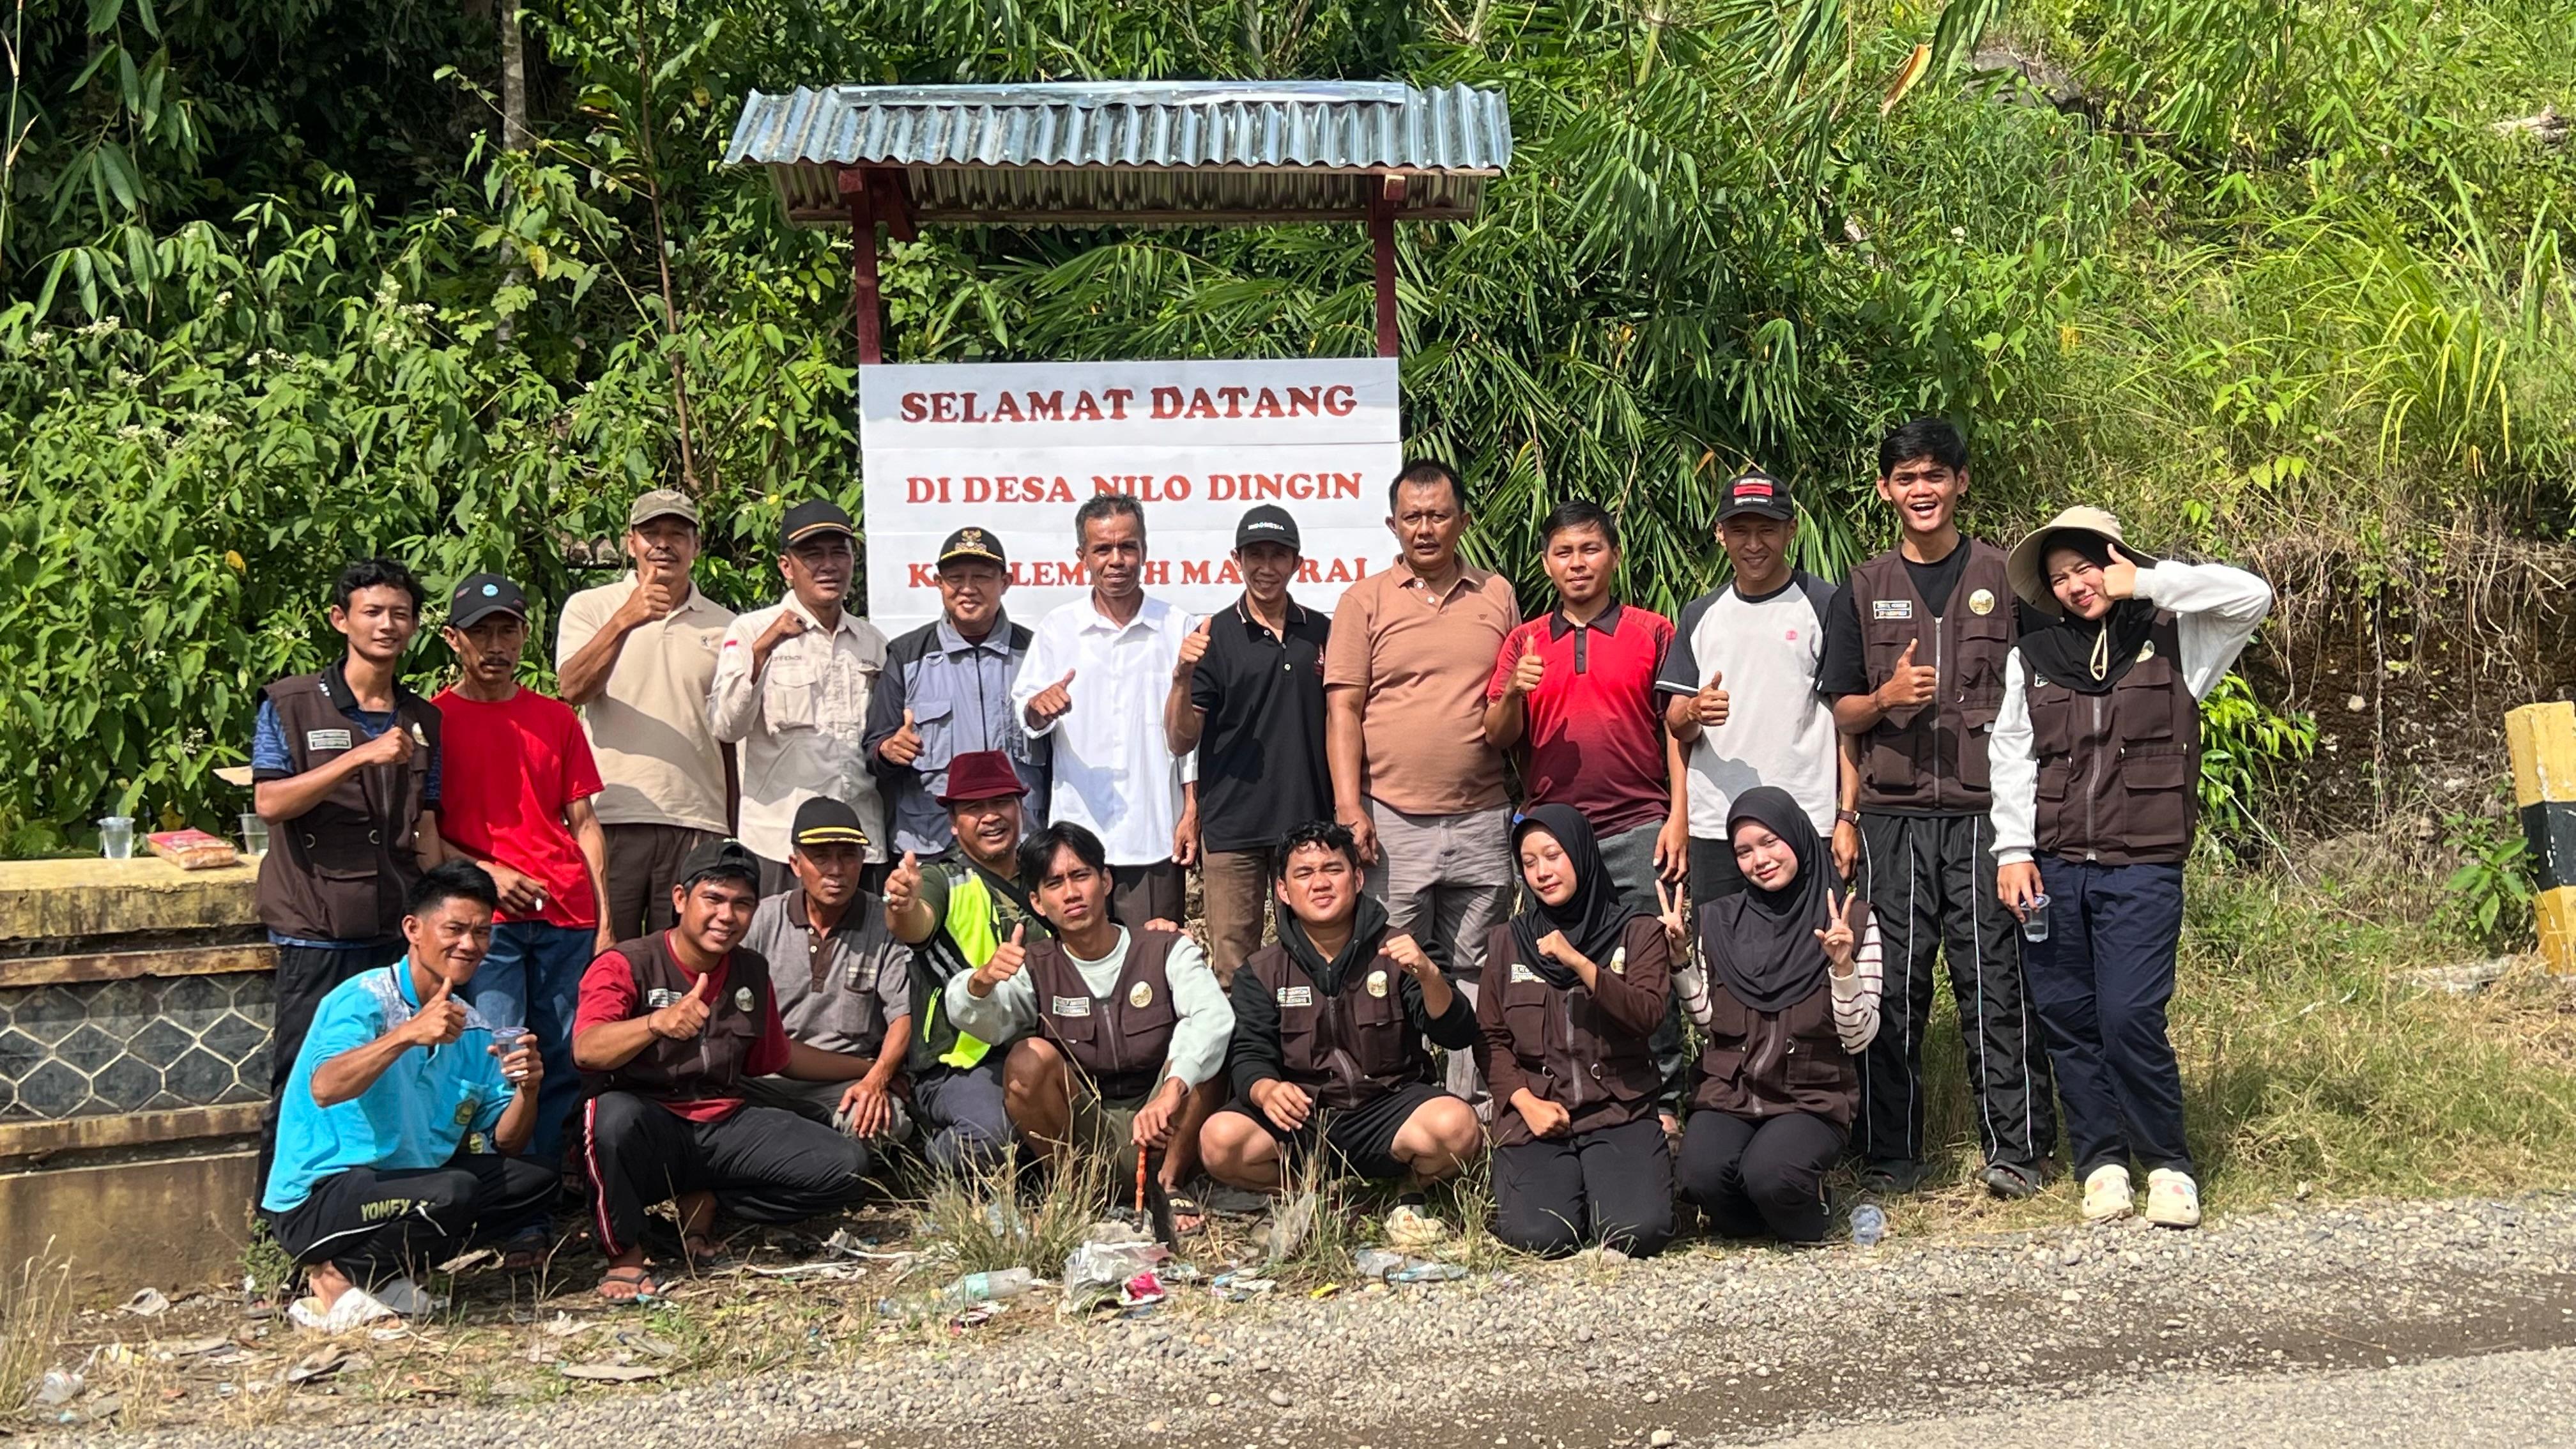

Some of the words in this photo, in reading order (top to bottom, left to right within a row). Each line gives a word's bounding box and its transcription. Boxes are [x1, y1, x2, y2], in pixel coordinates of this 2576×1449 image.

[901, 389, 1134, 422] SELAMAT
[1150, 385, 1357, 419] DATANG
[906, 476, 951, 503] DI
[963, 476, 1076, 503] DESA
[1091, 475, 1192, 502] NILO
[1208, 472, 1362, 501] DINGIN
[1009, 560, 1170, 586] LEMH
[1180, 558, 1367, 585] MARAI
